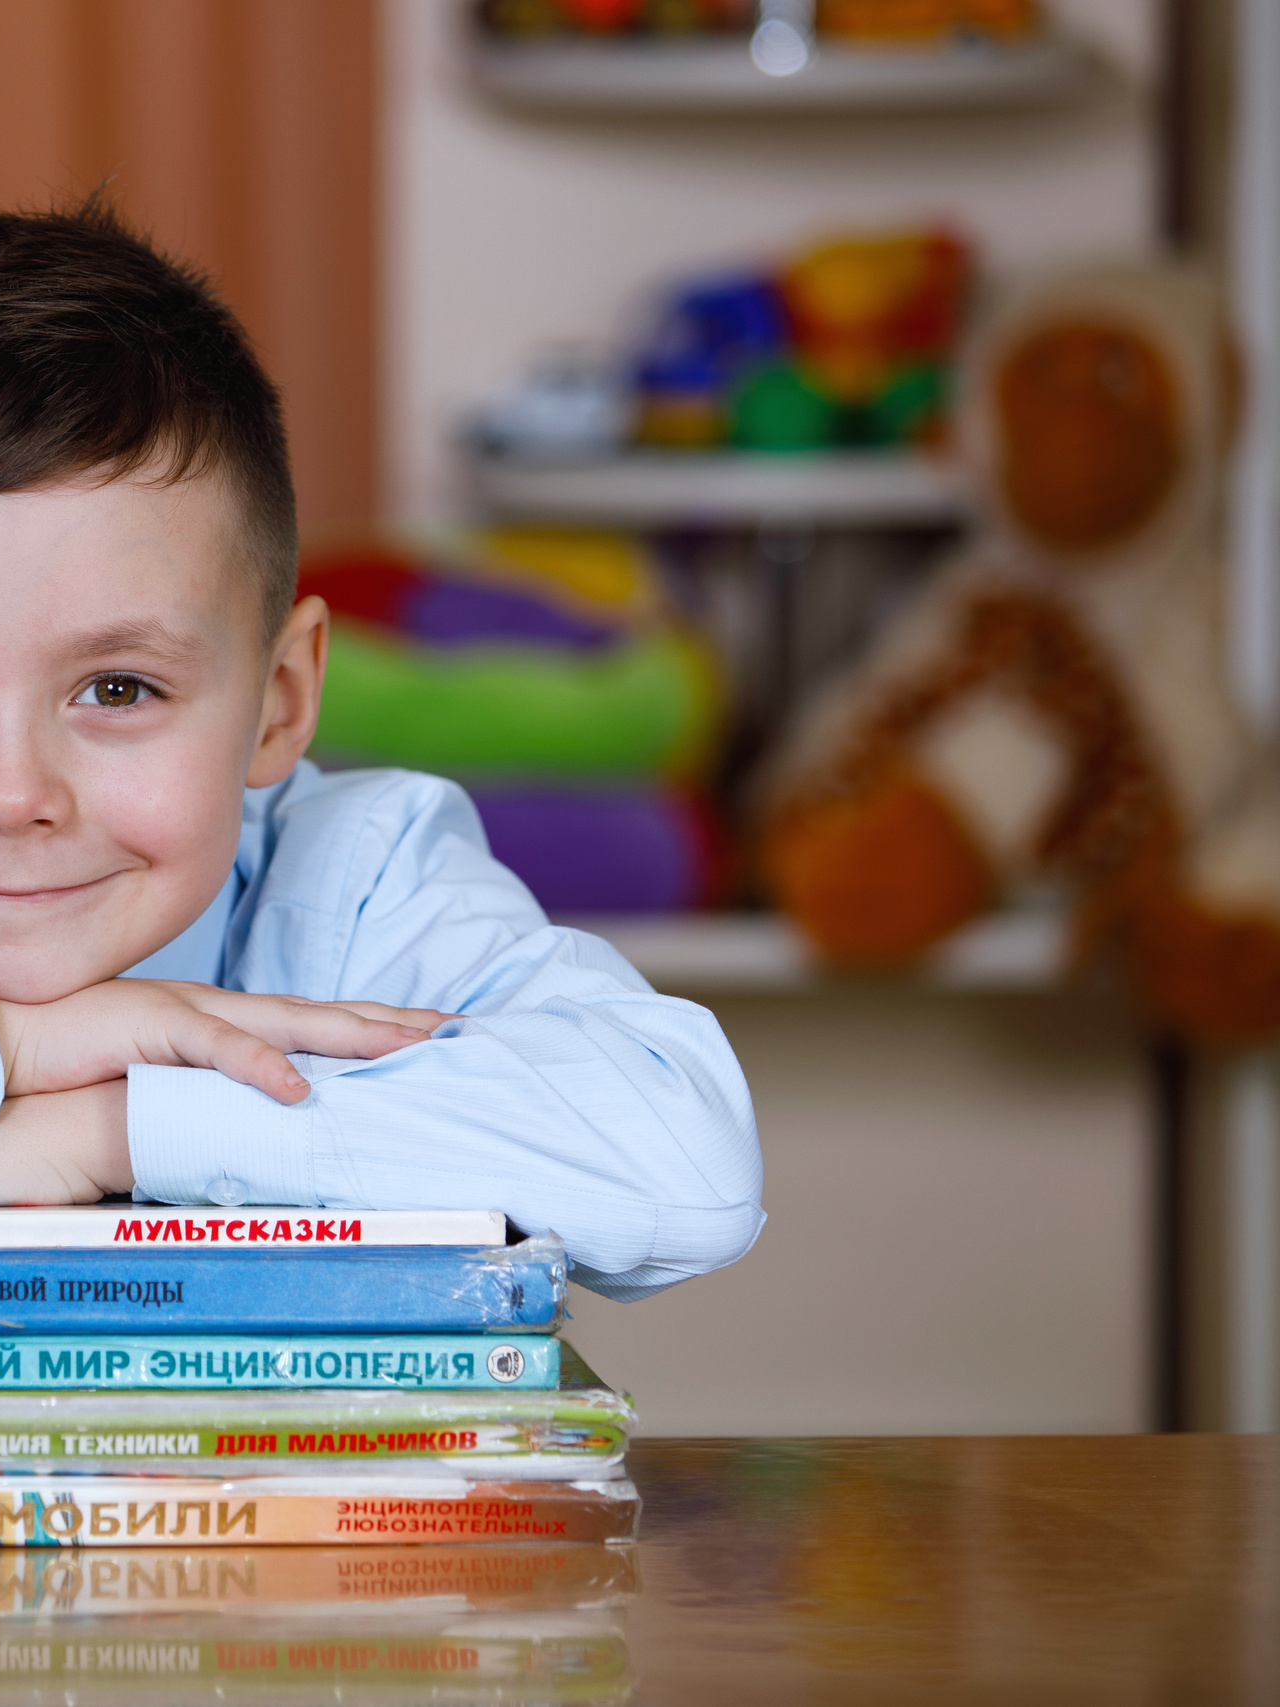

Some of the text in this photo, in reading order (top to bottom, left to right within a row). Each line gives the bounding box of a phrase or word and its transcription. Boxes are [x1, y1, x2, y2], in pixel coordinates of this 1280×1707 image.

[114, 1219, 362, 1242] МУЛЬТСКАЗКИ
[58, 1280, 184, 1308] ПРИРОДЫ
[38, 1350, 130, 1380] МИР
[150, 1350, 476, 1386] ЭНЦИКЛОПЕДИЯ
[60, 1433, 200, 1456] ТЕХНИКИ
[214, 1434, 277, 1456] ДЛЯ
[287, 1431, 478, 1454] МАЛЬЧИКОВ
[336, 1501, 534, 1518] ЭНЦИКЛОПЕДИЯ
[336, 1518, 568, 1535] ЛЮБОЗНАТЕЛЬНЫХ
